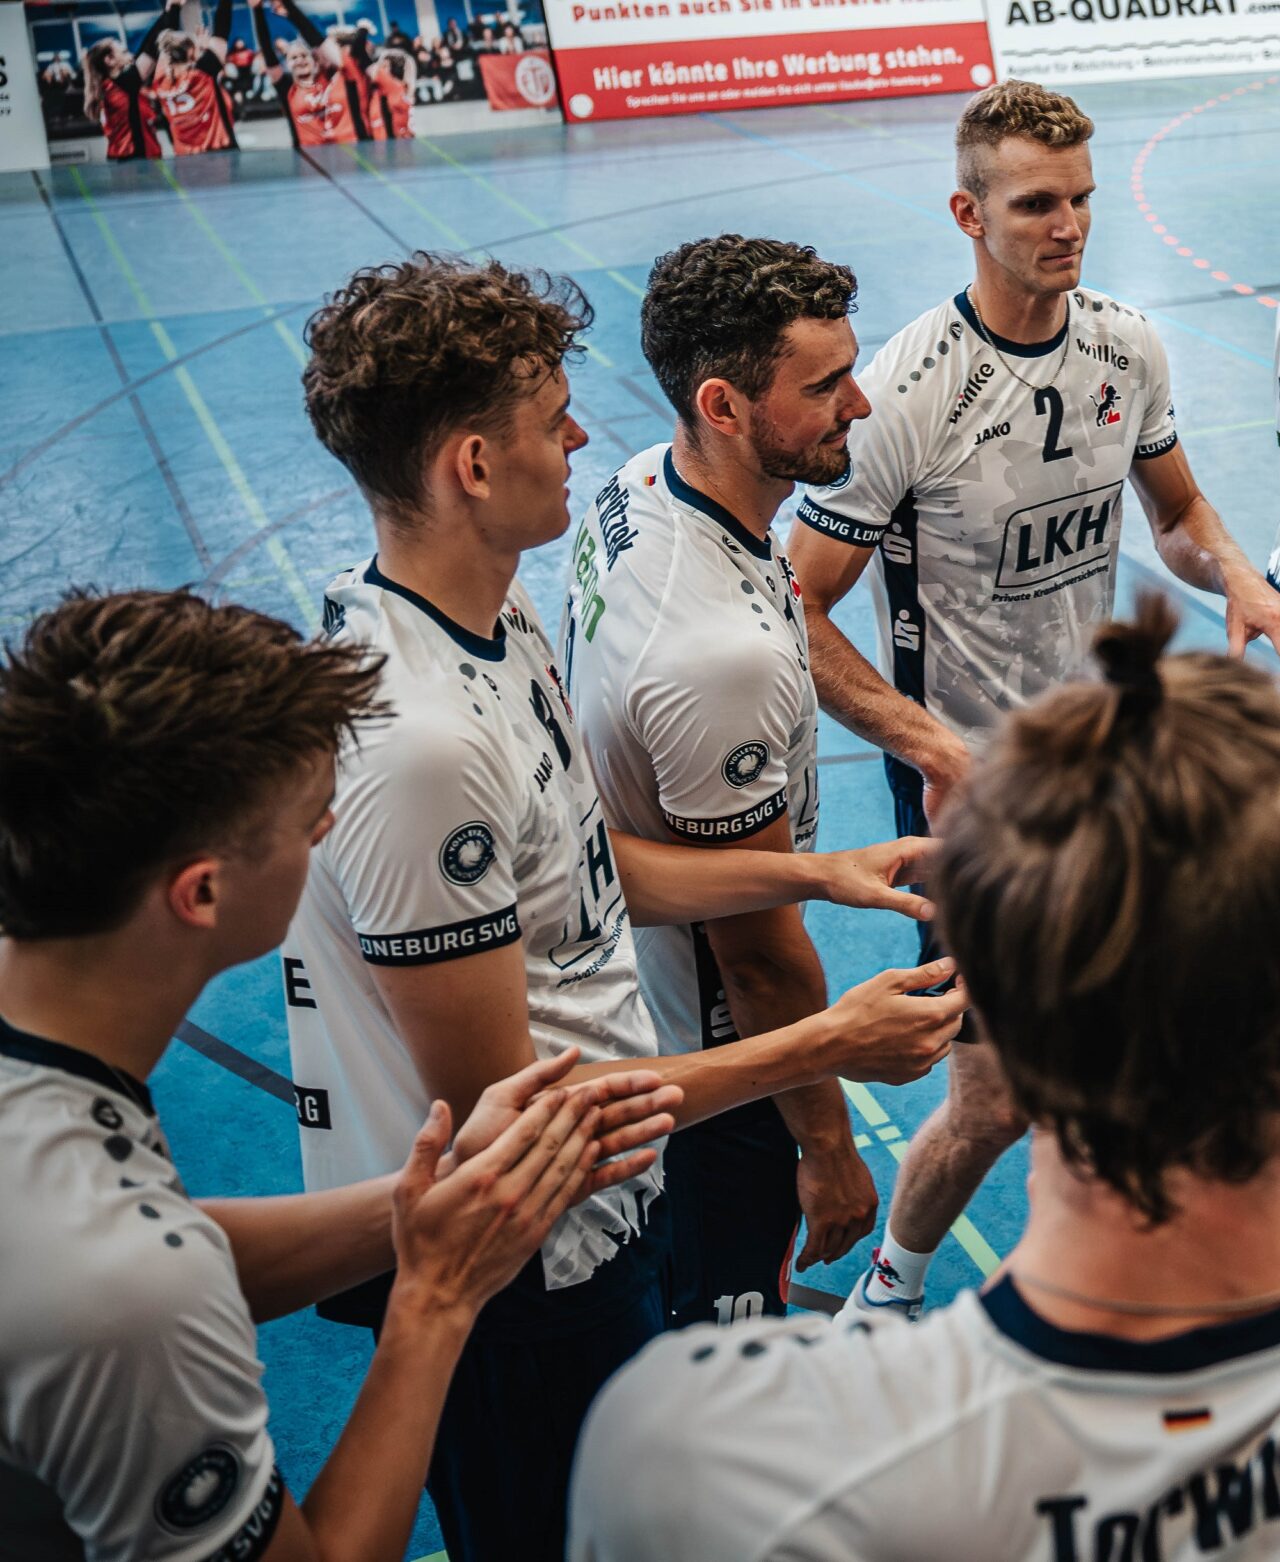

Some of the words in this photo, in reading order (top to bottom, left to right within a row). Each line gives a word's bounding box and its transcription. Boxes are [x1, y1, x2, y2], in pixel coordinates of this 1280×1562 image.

[572, 2, 670, 22] Punkten
[679, 0, 731, 15] auch
[1007, 0, 1238, 26] AB-QUADRAT
[592, 65, 643, 91] Hier
[647, 60, 729, 87] könnte
[731, 55, 779, 80] Ihre
[781, 50, 882, 76] Werbung
[884, 44, 964, 69] stehen.
[1076, 338, 1130, 371] willke
[949, 362, 995, 424] willke
[974, 421, 1011, 446] JAKO
[1033, 385, 1073, 463] 2
[595, 465, 640, 572] arlitzek
[818, 514, 851, 536] SVG
[1015, 498, 1111, 574] LKH
[992, 592, 1031, 602] Private
[744, 800, 774, 829] SVG
[576, 818, 615, 943] LH
[478, 913, 517, 943] SVG
